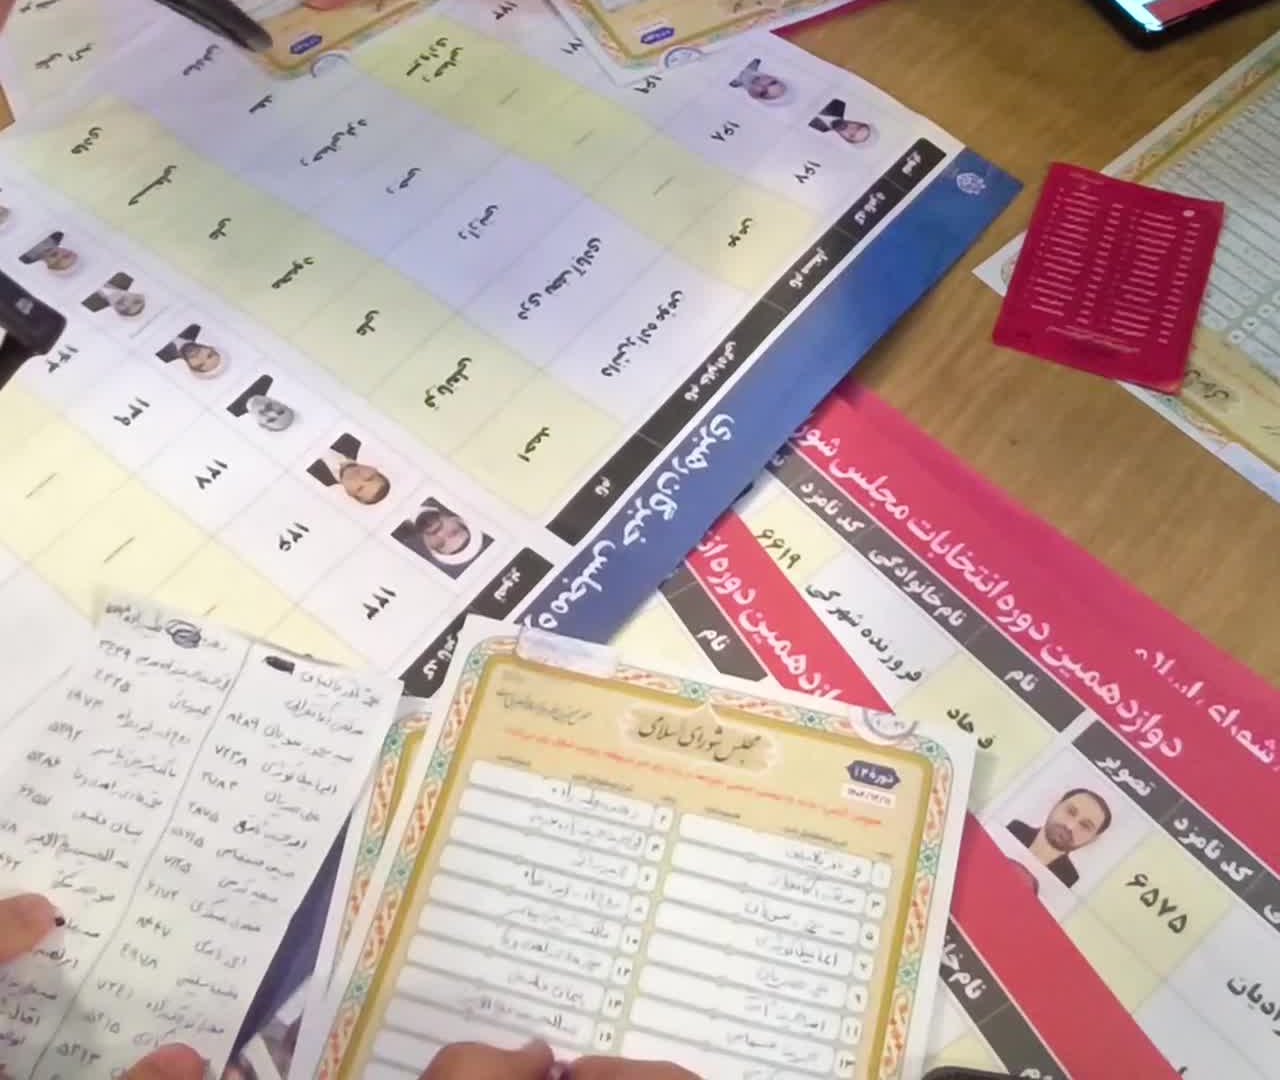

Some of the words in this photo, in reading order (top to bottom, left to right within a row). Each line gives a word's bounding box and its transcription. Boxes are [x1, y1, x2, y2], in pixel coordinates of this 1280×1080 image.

[70, 126, 102, 155] هادی
[710, 121, 740, 142] ۱۶۸
[795, 161, 821, 184] ۱۶۷
[208, 217, 232, 240] علی
[271, 256, 314, 289] محمود
[789, 272, 803, 288] نام
[355, 309, 380, 336] علی
[424, 357, 472, 408] قربانعلی
[113, 398, 150, 427] ۱۳۹
[518, 426, 550, 463] احمد
[195, 460, 228, 490] ۱۲۷
[594, 477, 611, 496] نام
[828, 459, 909, 520] مجلس
[550, 530, 616, 614] مجلس
[622, 471, 680, 546] خبرگان
[671, 402, 734, 474] رهبری
[800, 483, 839, 515] نامزد
[278, 523, 310, 552] ۱۲۶
[838, 517, 865, 532] کد
[750, 529, 801, 569] ۶۶۱۹
[906, 519, 1009, 598] انتخابات
[494, 568, 521, 600] تصویر
[708, 558, 756, 605] دوره
[363, 587, 396, 620] ۱۲۳
[805, 585, 862, 628] شهرکی
[996, 594, 1050, 641] دوره
[697, 630, 727, 651] نام
[422, 659, 438, 680] کد
[1004, 670, 1035, 692] نام
[1033, 645, 1183, 758] دوازدهمین
[1090, 757, 1151, 796] تصویر
[1162, 818, 1221, 860] نامزد
[1220, 861, 1254, 882] کد
[1126, 873, 1188, 934] ۶۵۷۵
[949, 972, 982, 999] نام
